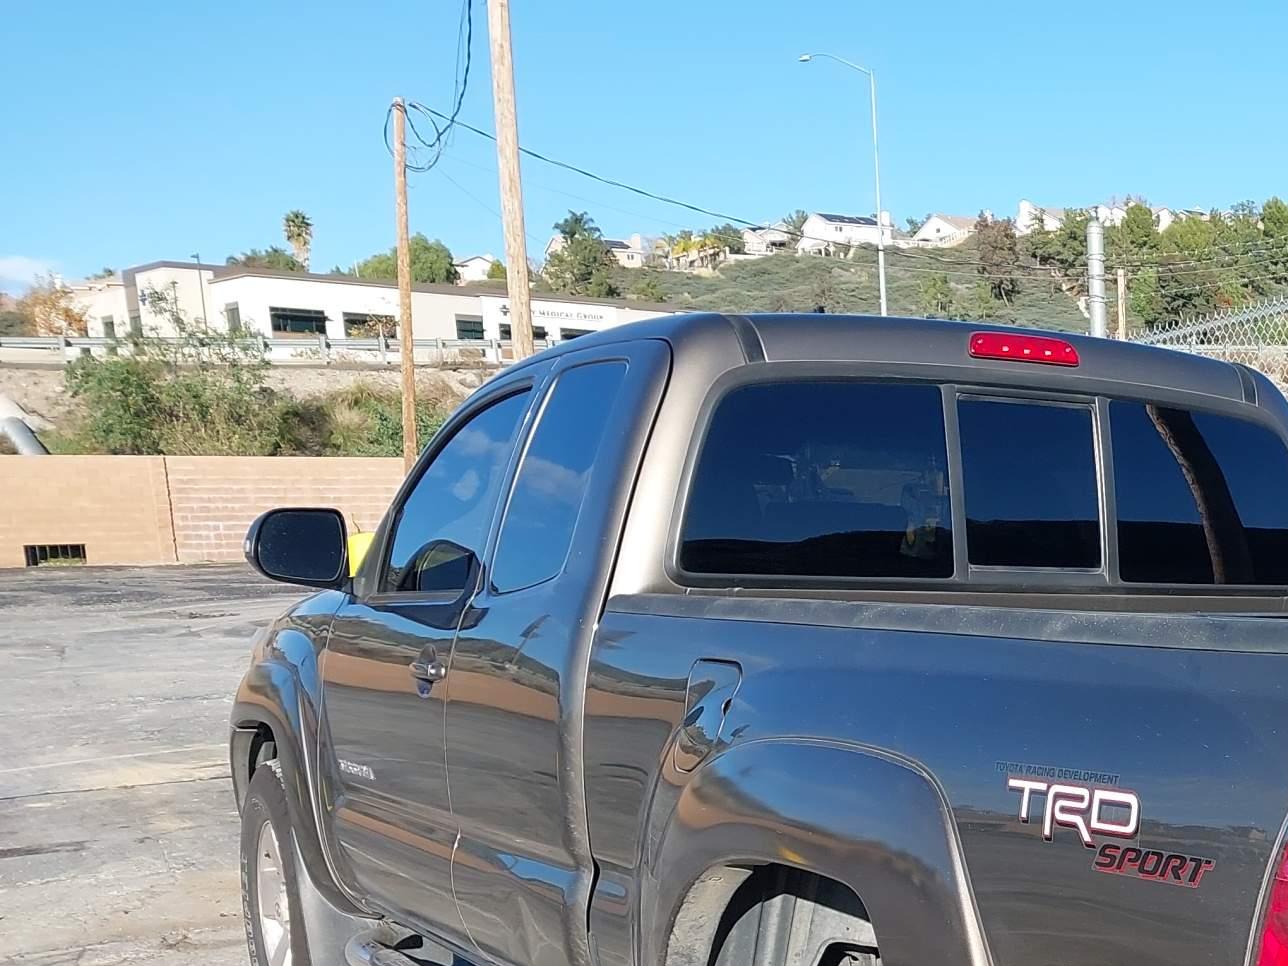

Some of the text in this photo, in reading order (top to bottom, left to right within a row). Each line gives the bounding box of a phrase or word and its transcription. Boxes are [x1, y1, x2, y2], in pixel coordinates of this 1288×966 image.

[995, 761, 1120, 785] TOYOTA RACING DEVELOPMENT
[1008, 777, 1140, 848] TRD
[1094, 844, 1215, 887] SPORT
